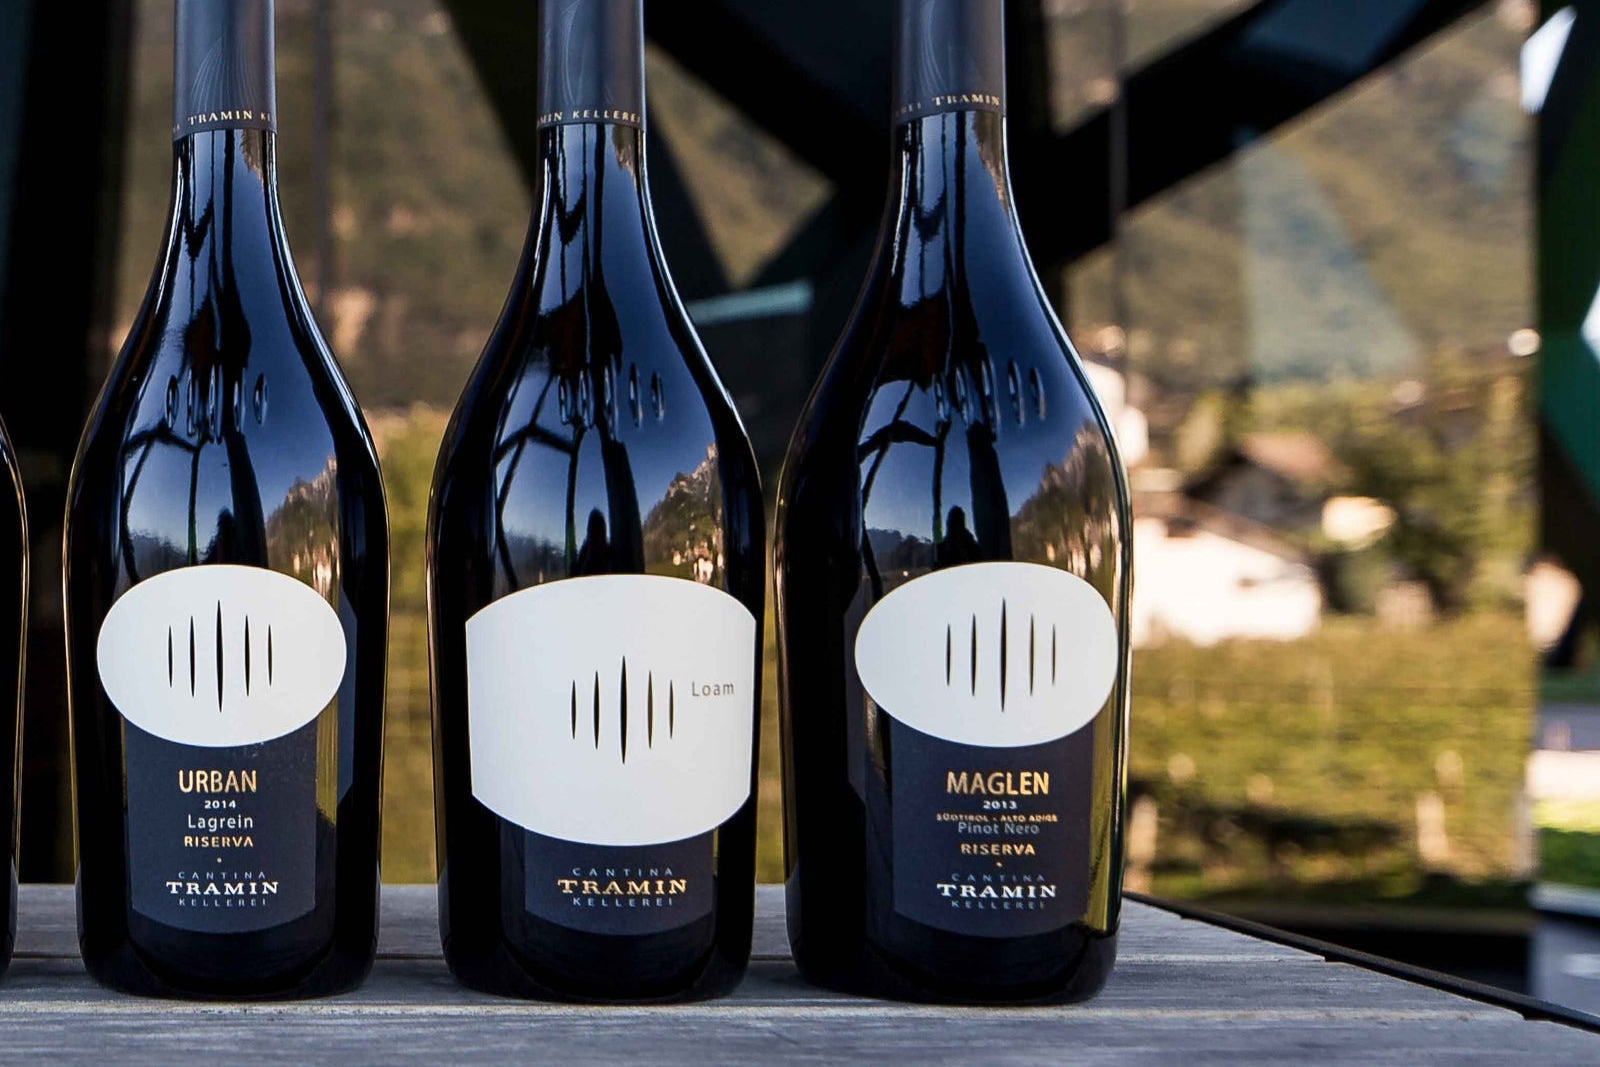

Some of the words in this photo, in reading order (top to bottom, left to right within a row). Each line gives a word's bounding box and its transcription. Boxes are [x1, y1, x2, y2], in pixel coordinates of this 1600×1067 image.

[932, 94, 1000, 106] TRAMIN
[188, 110, 253, 125] TRAMIN
[691, 681, 735, 698] Loam
[178, 769, 258, 794] URBAN
[946, 771, 1050, 795] MAGLEN
[204, 799, 237, 809] 2014
[982, 800, 1018, 810] 2013
[187, 814, 254, 833] Lagrein
[957, 821, 1000, 834] Pinot
[1004, 821, 1040, 835] Nero
[183, 835, 254, 848] RISERVA
[960, 843, 1036, 855] RISERVA
[178, 871, 266, 880] CANTINA
[572, 867, 674, 877] CANTINA
[951, 873, 1045, 882] CANTINA
[165, 881, 280, 896] TRAMIN
[557, 878, 687, 895] TRAMIN
[936, 883, 1057, 899] TRAMIN
[179, 897, 267, 907] KELLEREI
[572, 896, 674, 907] KELLEREI
